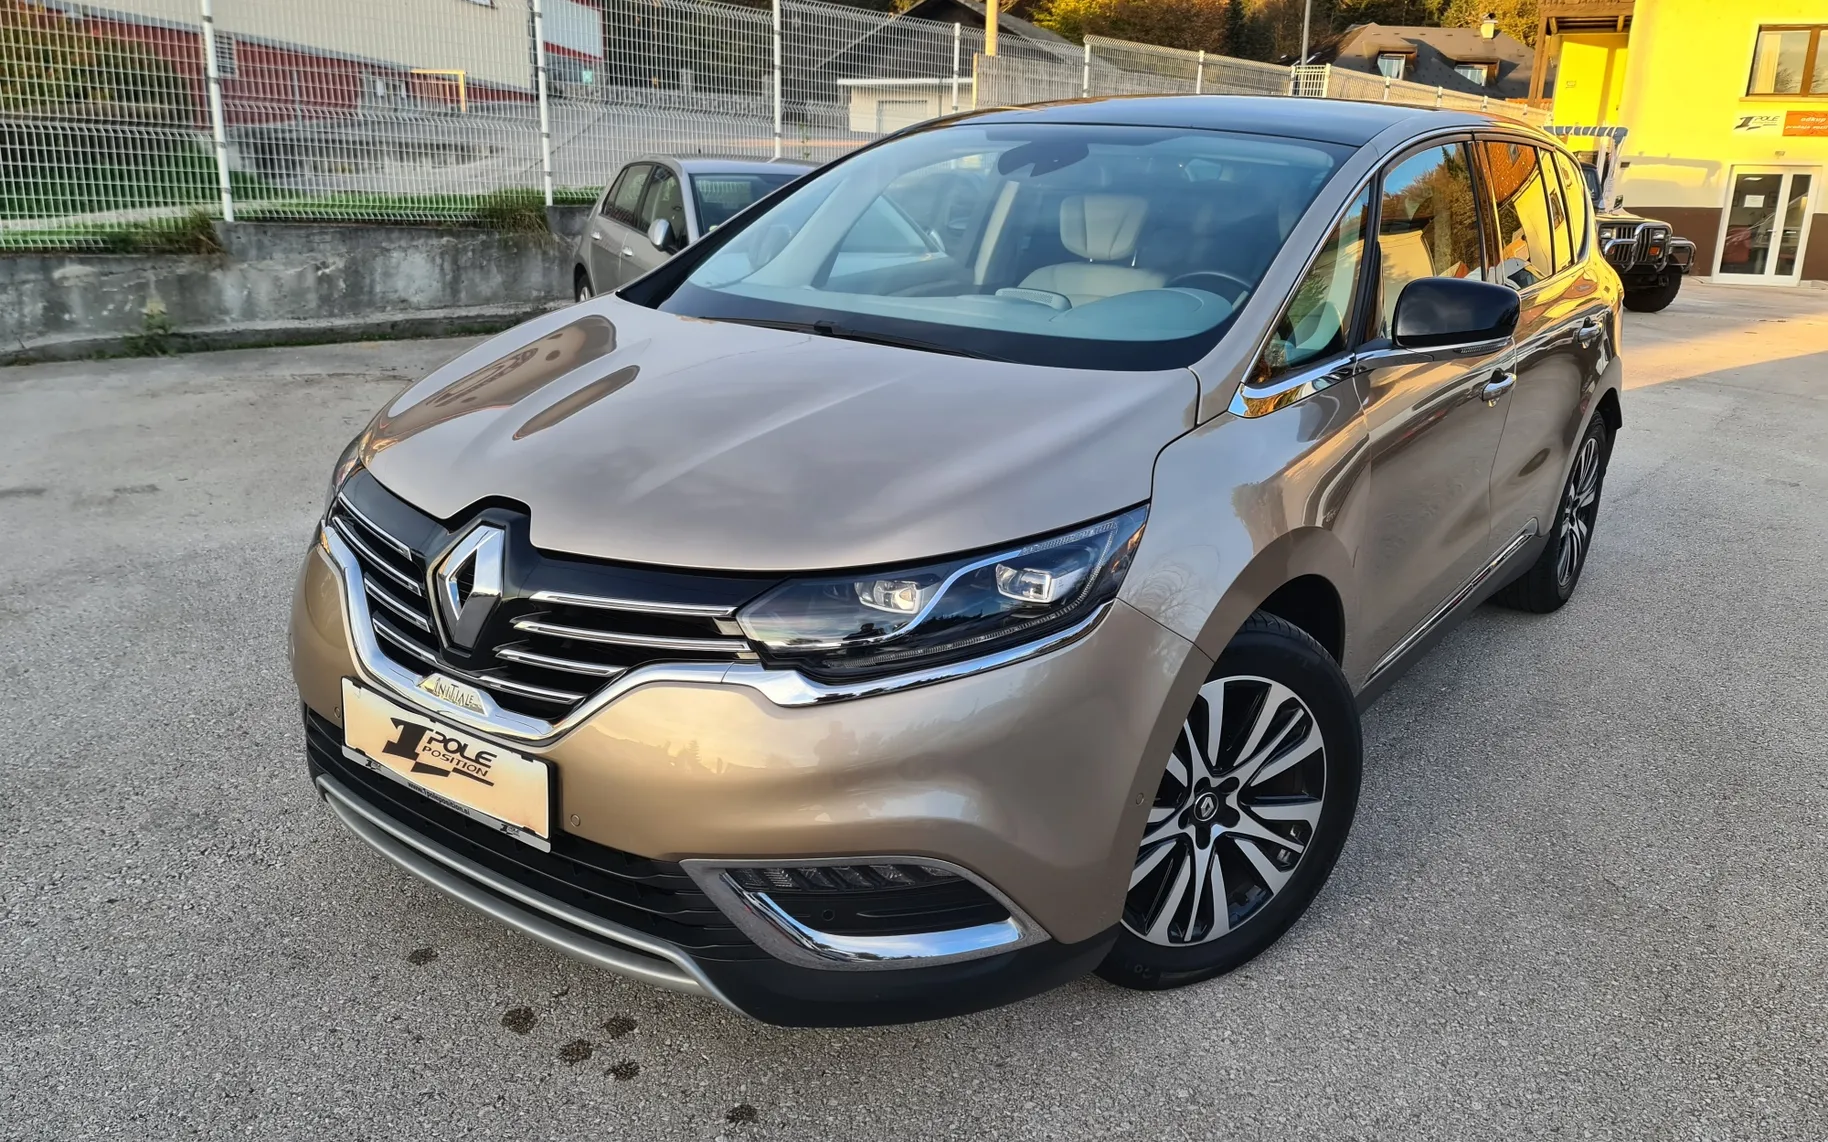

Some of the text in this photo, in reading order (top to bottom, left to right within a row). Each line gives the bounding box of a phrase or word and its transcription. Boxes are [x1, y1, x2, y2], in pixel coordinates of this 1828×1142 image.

[435, 678, 474, 706] INITIALE
[422, 745, 488, 777] POSITION
[427, 731, 498, 769] POLE
